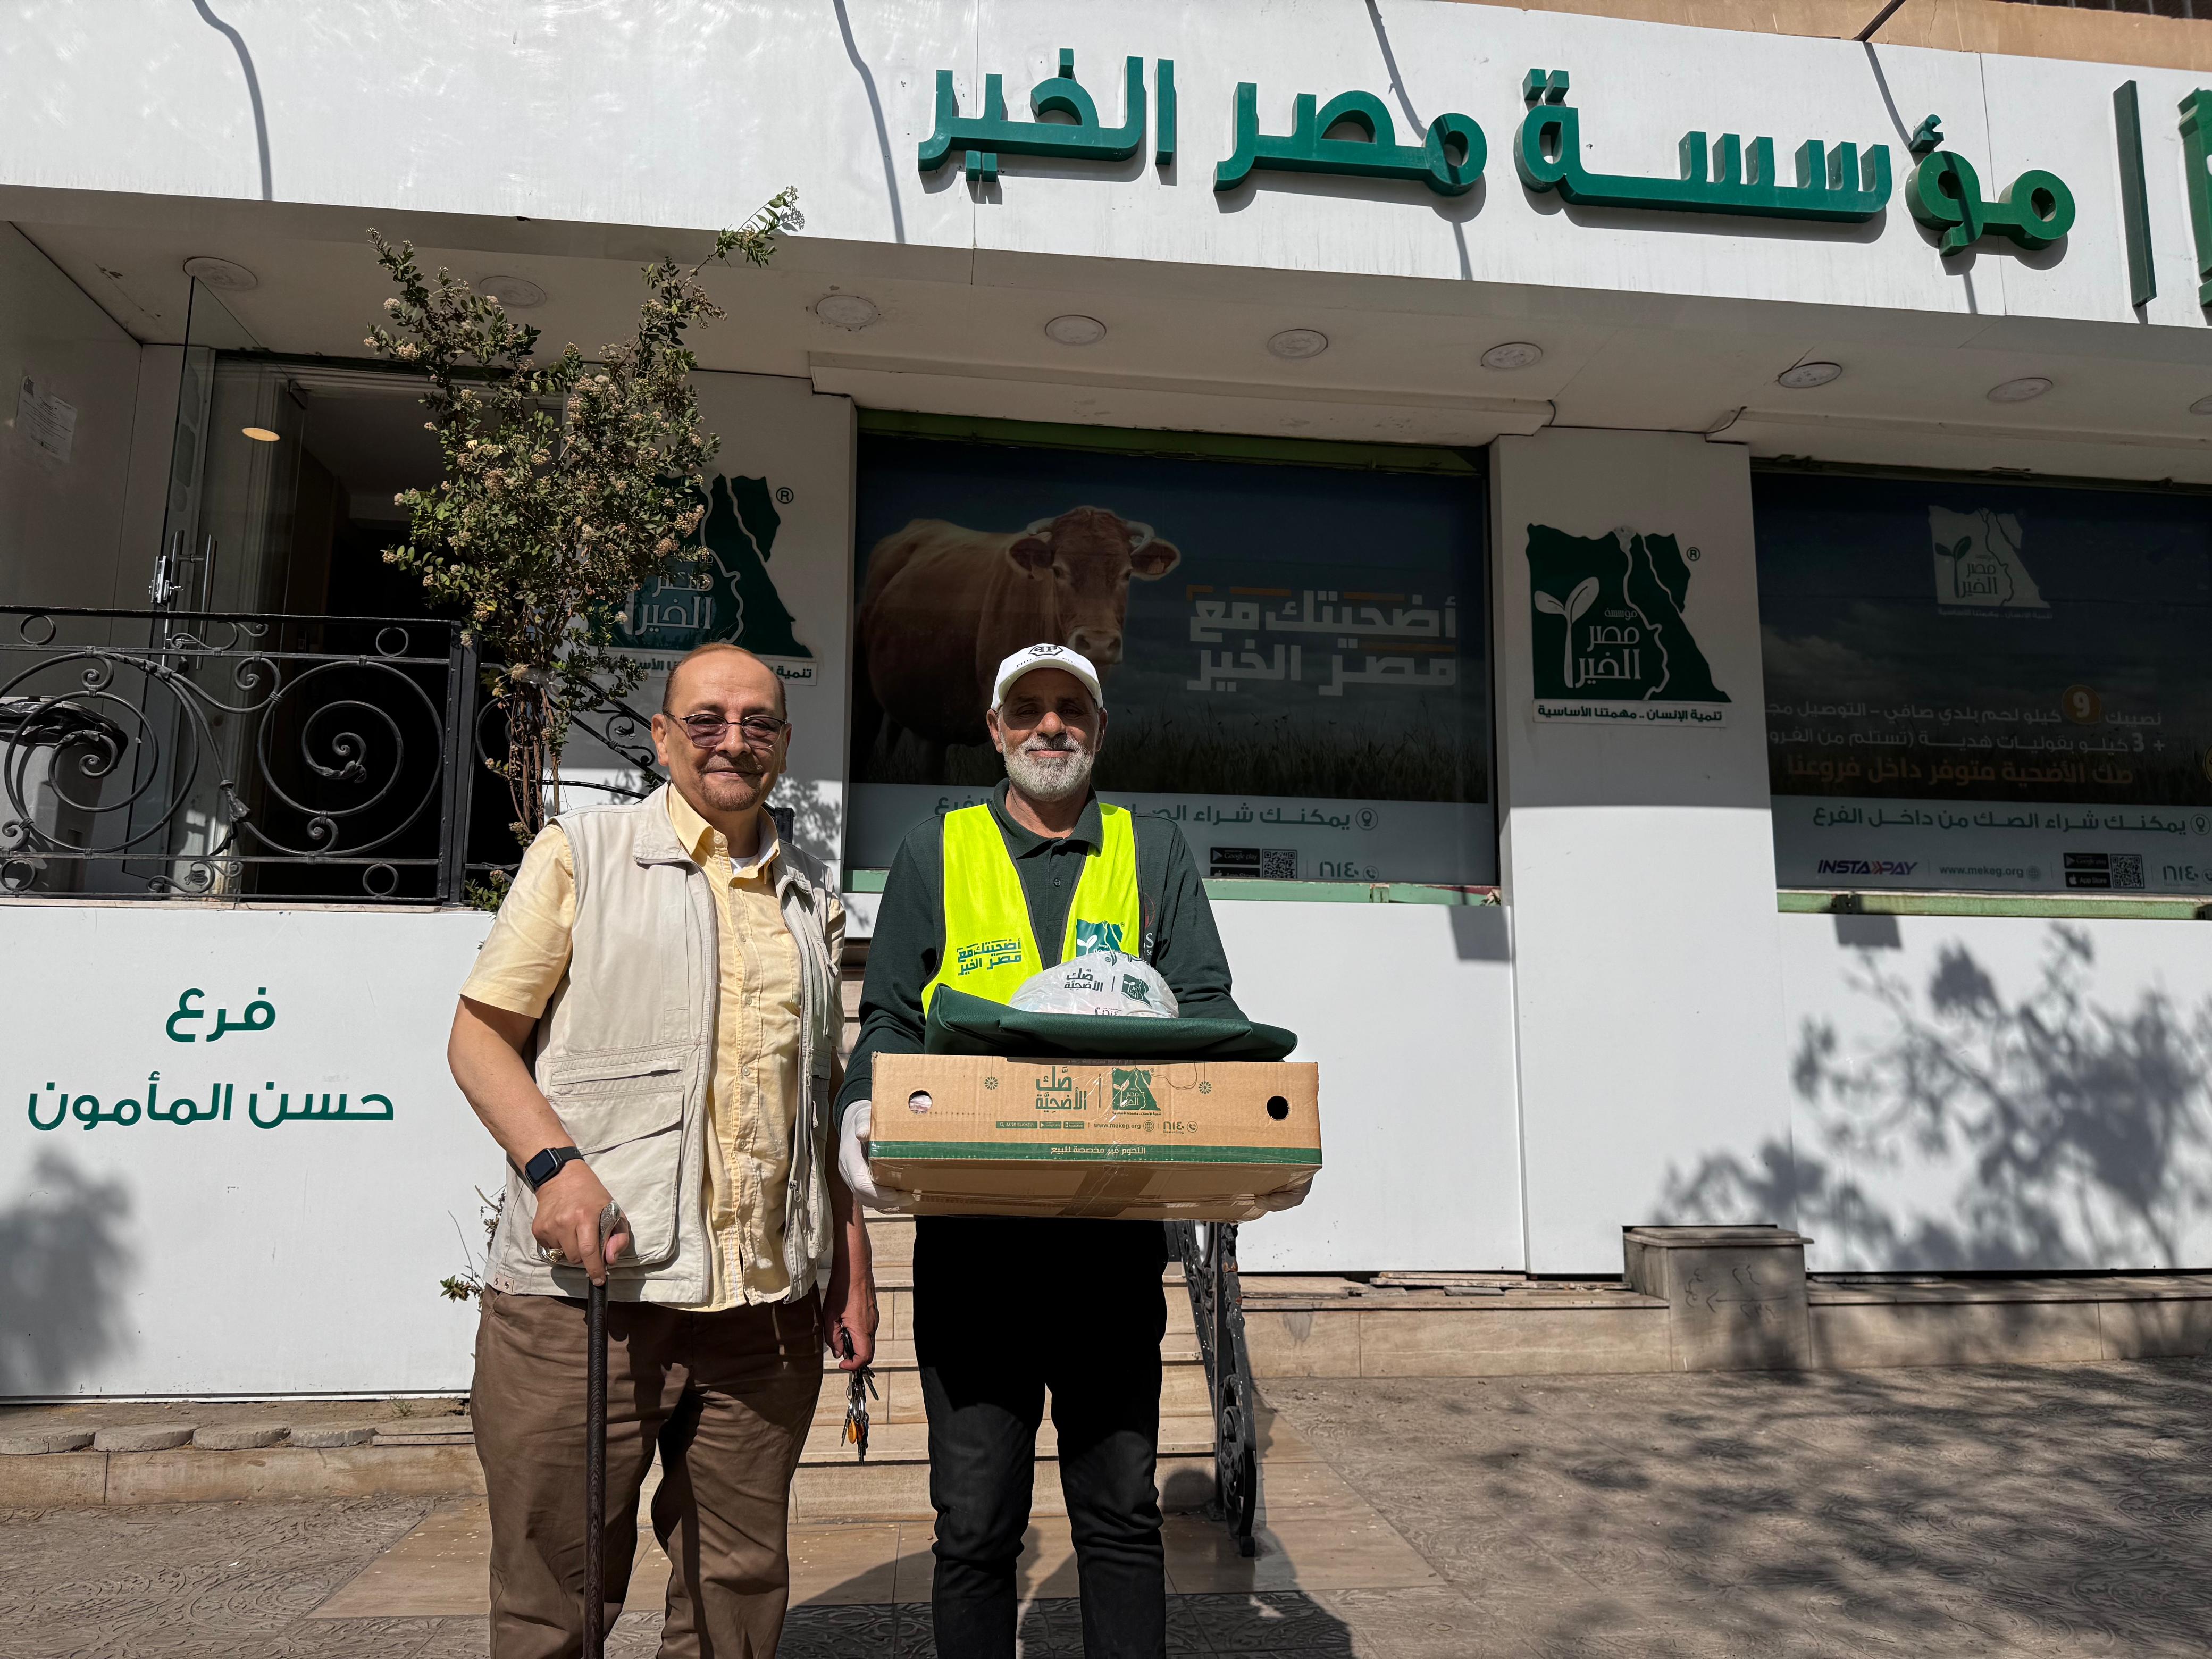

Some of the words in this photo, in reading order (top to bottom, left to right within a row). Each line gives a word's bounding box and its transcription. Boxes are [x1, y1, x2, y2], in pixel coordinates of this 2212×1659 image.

[917, 48, 1175, 182] الخير
[1213, 82, 1487, 196] مصر
[1514, 68, 2075, 256] مؤسسة
[635, 596, 713, 636] الخير
[1189, 600, 1259, 642] مع
[1266, 590, 1456, 644] أضحيتك
[1604, 608, 1637, 620] مؤسسة
[1587, 626, 1640, 652] مصر
[777, 666, 811, 678] تنمية
[1187, 639, 1301, 691] الخير
[1318, 654, 1456, 696] مصر
[1575, 648, 1641, 689] الخير
[1538, 705, 1591, 717] الأساسية
[1595, 707, 1637, 718] مهمتنا
[1884, 704, 1934, 724] صافي
[2073, 692, 2090, 717] 9
[1647, 709, 1688, 722] الإنسان
[1691, 709, 1722, 722] تنمية
[1938, 707, 1978, 725] بلدي
[1982, 708, 2018, 723] لحم
[2024, 710, 2062, 725] كيلو
[1817, 730, 1844, 745] من
[2132, 732, 2144, 752] 3
[1867, 757, 1922, 783] داخل
[1928, 758, 1996, 786] متوفر
[1194, 803, 1253, 825] شراء
[1260, 807, 1350, 830] يمكنك
[1813, 806, 1862, 826] الفرع
[1868, 808, 1933, 827] داخل
[1937, 810, 1968, 829] من
[1974, 811, 2039, 828] الصك
[2045, 810, 2098, 832] شراء
[2104, 815, 2185, 834] يمكنك
[1939, 864, 2023, 878] www.mekeg.org
[958, 958, 982, 976] الخير
[986, 954, 1021, 970] مصر
[166, 987, 276, 1042] فرع
[28, 1071, 233, 1131] المأمون
[249, 1081, 393, 1129] حسن
